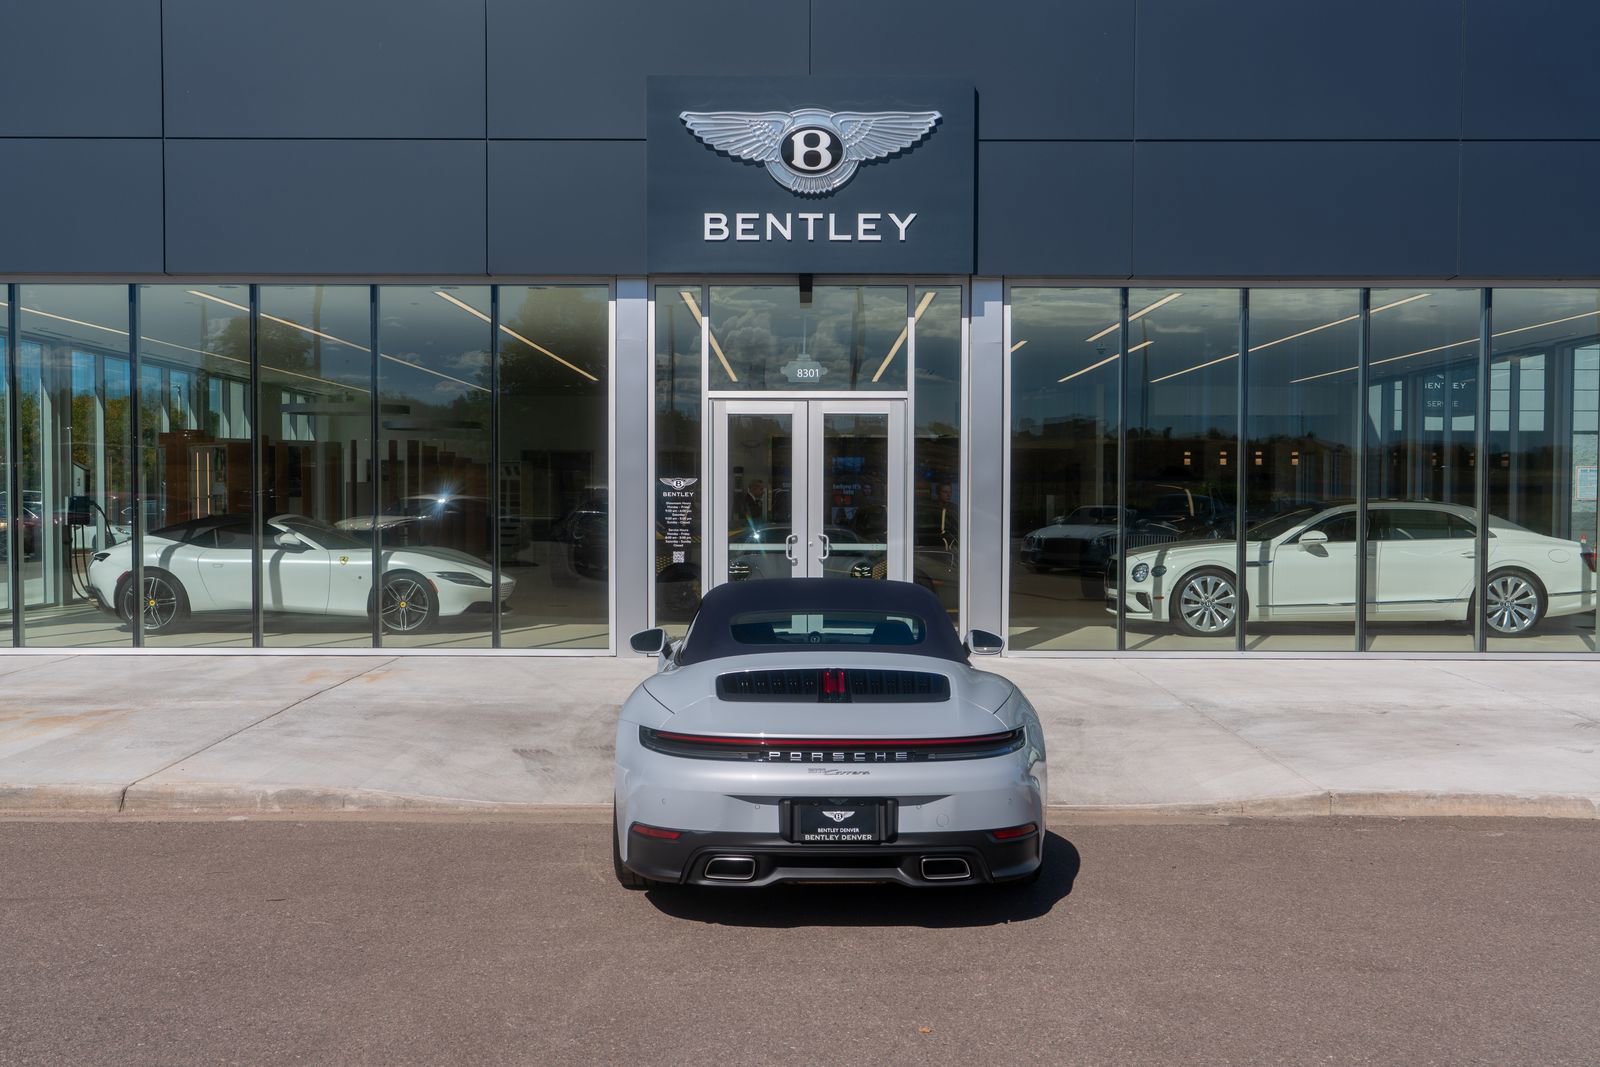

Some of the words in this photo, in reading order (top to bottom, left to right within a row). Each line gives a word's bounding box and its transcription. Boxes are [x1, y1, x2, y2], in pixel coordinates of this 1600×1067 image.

[791, 129, 832, 171] B
[703, 212, 918, 241] BENTLEY
[796, 368, 819, 378] 8301
[768, 751, 908, 762] PORSCHE
